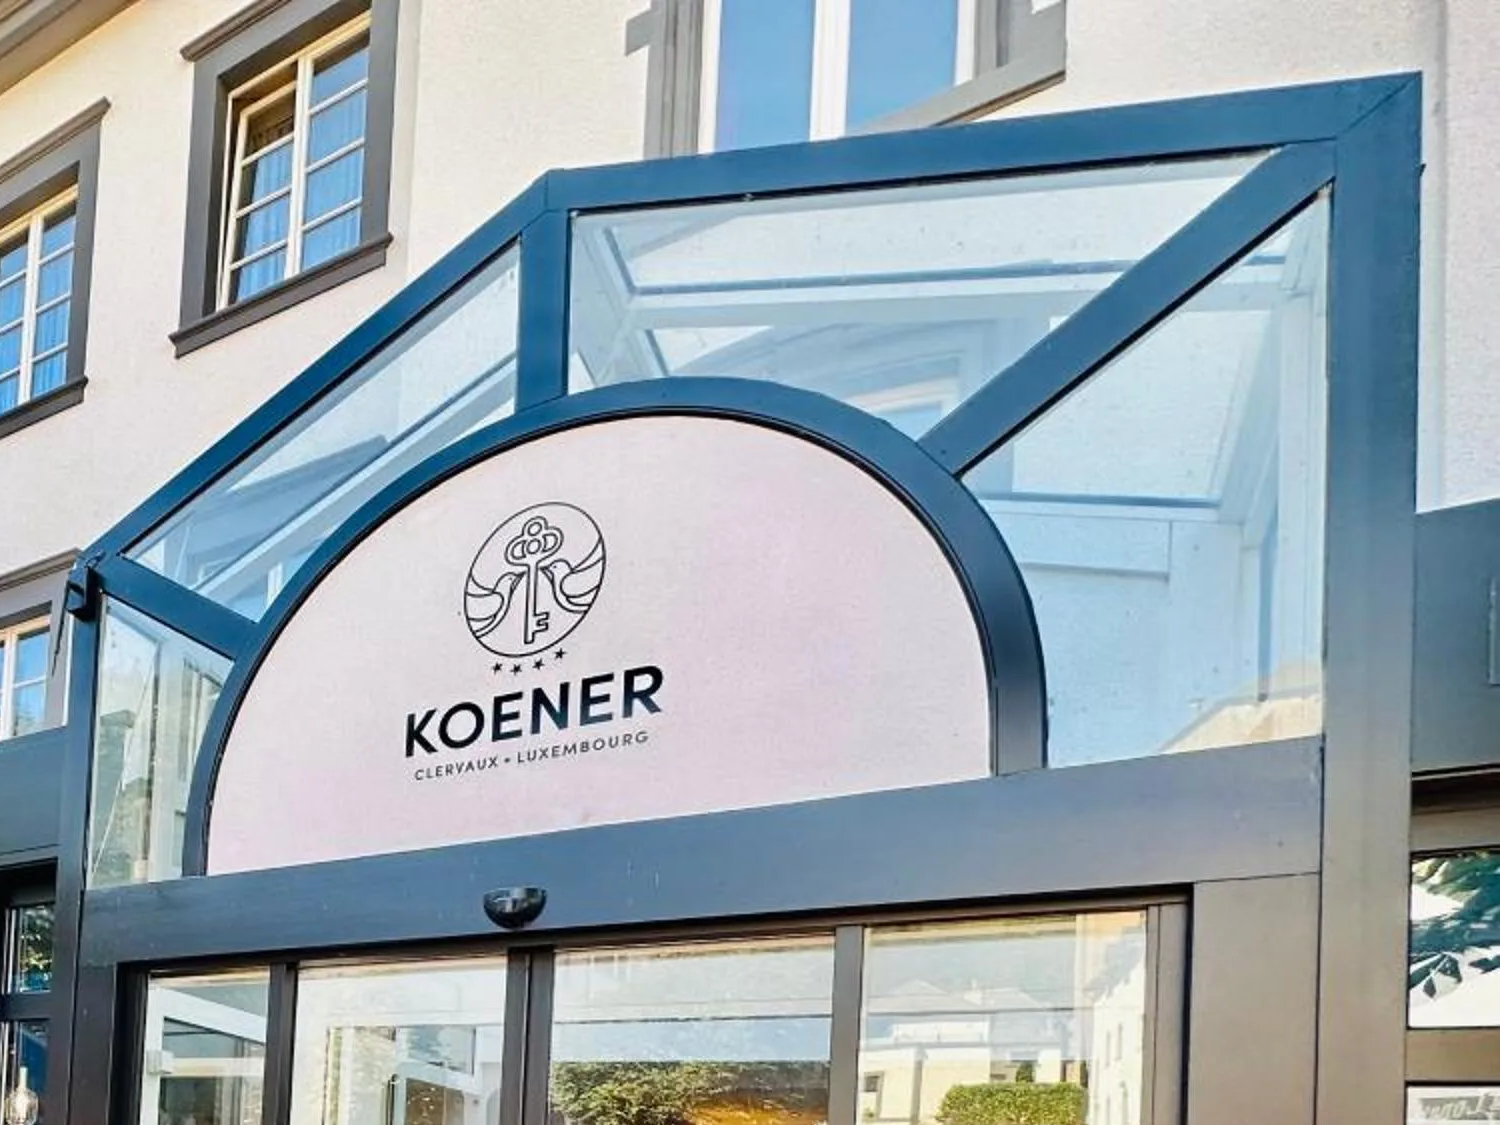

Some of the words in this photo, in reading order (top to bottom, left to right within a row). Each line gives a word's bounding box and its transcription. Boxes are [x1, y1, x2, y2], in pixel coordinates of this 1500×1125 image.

[405, 665, 664, 758] KOENER
[414, 756, 498, 781] CLERVAUX
[517, 731, 649, 764] LUXEMBOURG
